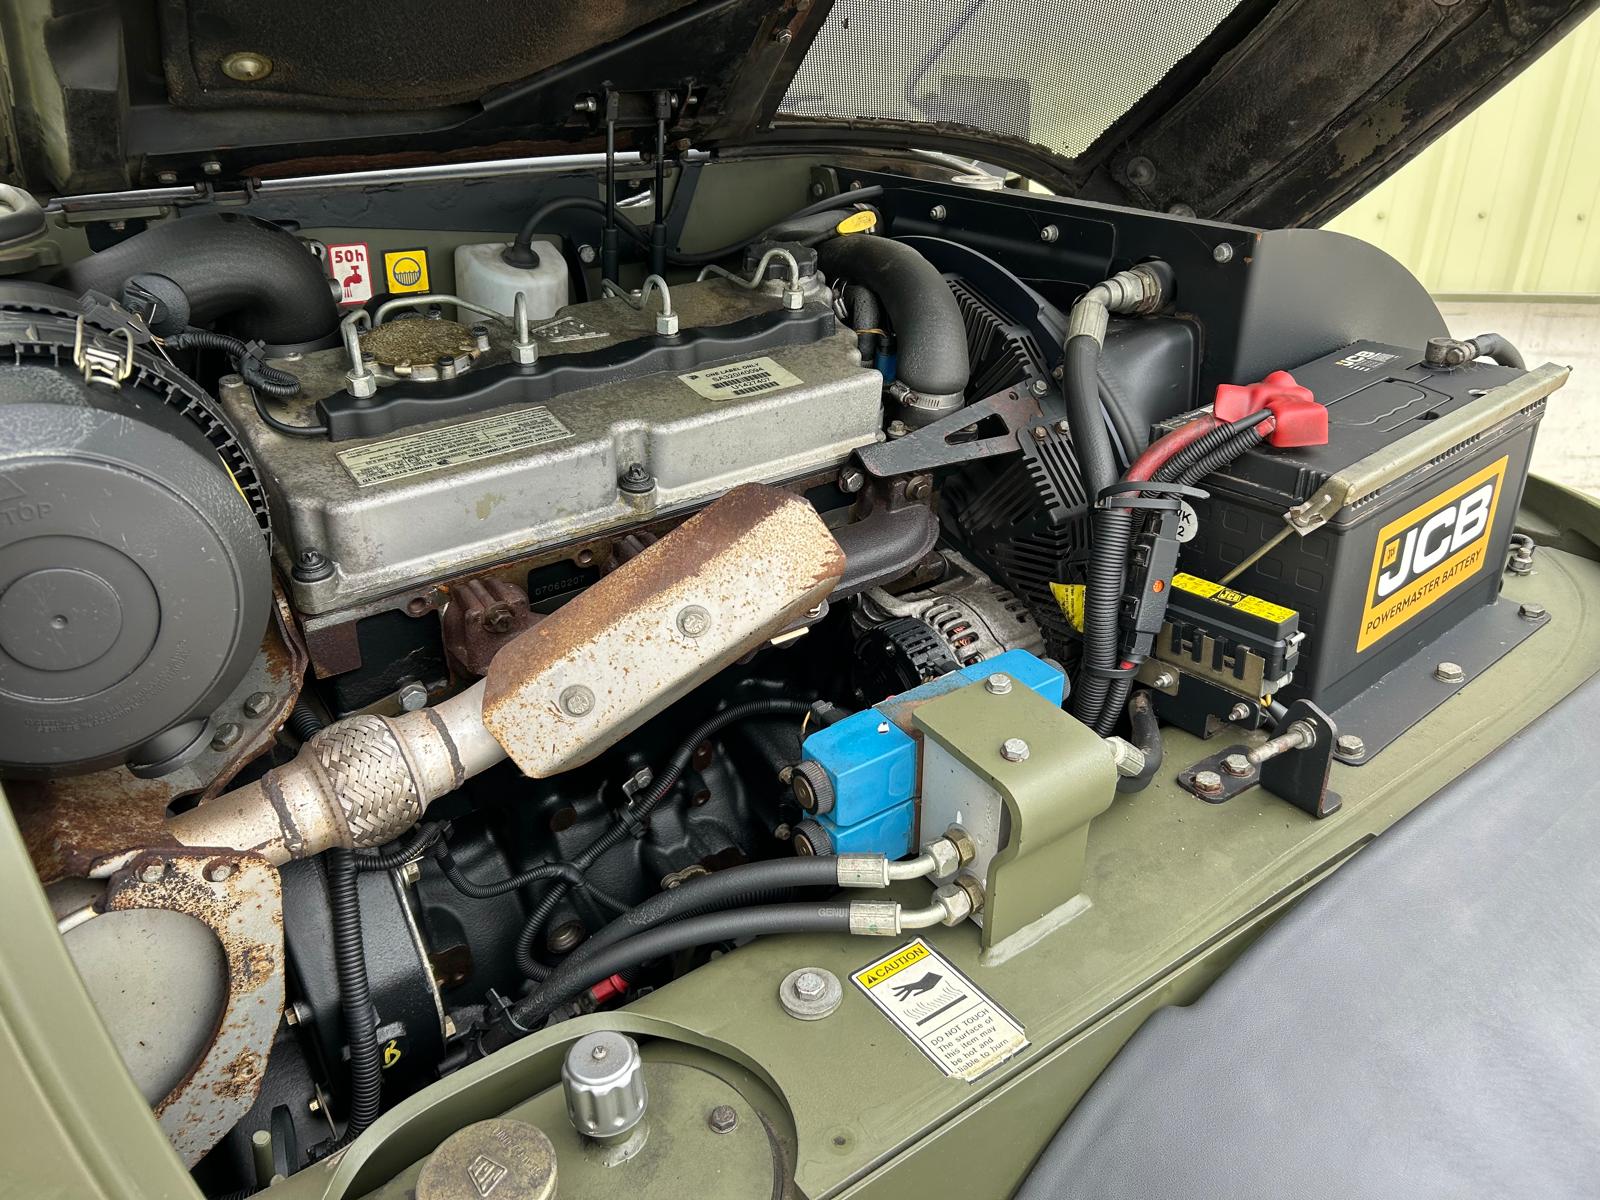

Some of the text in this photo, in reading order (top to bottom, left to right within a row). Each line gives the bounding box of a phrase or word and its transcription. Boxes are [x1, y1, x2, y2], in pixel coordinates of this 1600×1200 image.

[335, 249, 364, 263] 50h
[1378, 485, 1493, 597] JCB
[1365, 547, 1483, 635] POWERMASTER BATTERY
[875, 947, 924, 977] CAUTION
[931, 1009, 990, 1047] DO NOT TOUCH
[938, 1017, 994, 1052] The surface of
[945, 1026, 997, 1060] this item may
[951, 1037, 994, 1067] be hot and
[980, 1051, 990, 1059] to
